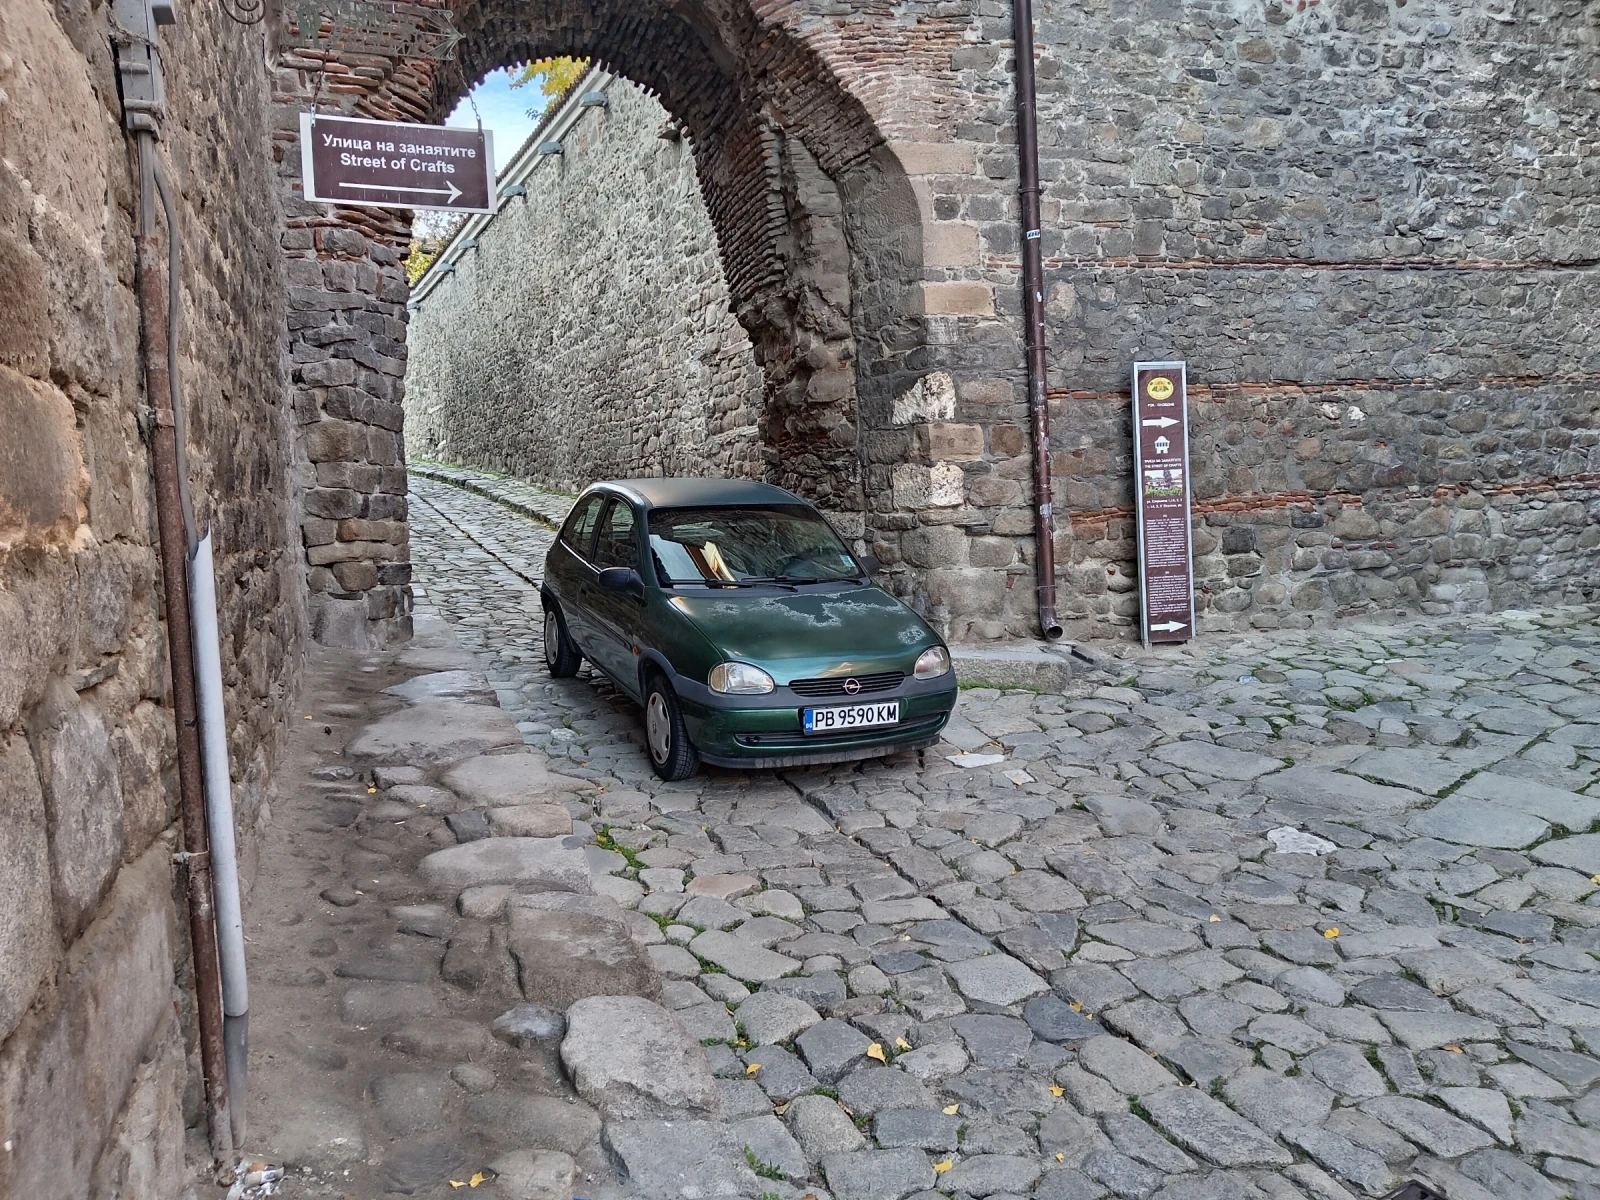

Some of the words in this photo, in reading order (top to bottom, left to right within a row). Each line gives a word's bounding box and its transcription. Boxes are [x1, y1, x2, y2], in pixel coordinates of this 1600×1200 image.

[322, 133, 372, 151] Улица
[376, 141, 395, 152] на
[399, 142, 476, 159] занаятите
[340, 153, 387, 169] Street
[391, 157, 406, 170] of
[410, 158, 455, 174] Crafts
[838, 708, 874, 725] 9590
[877, 705, 897, 722] KM
